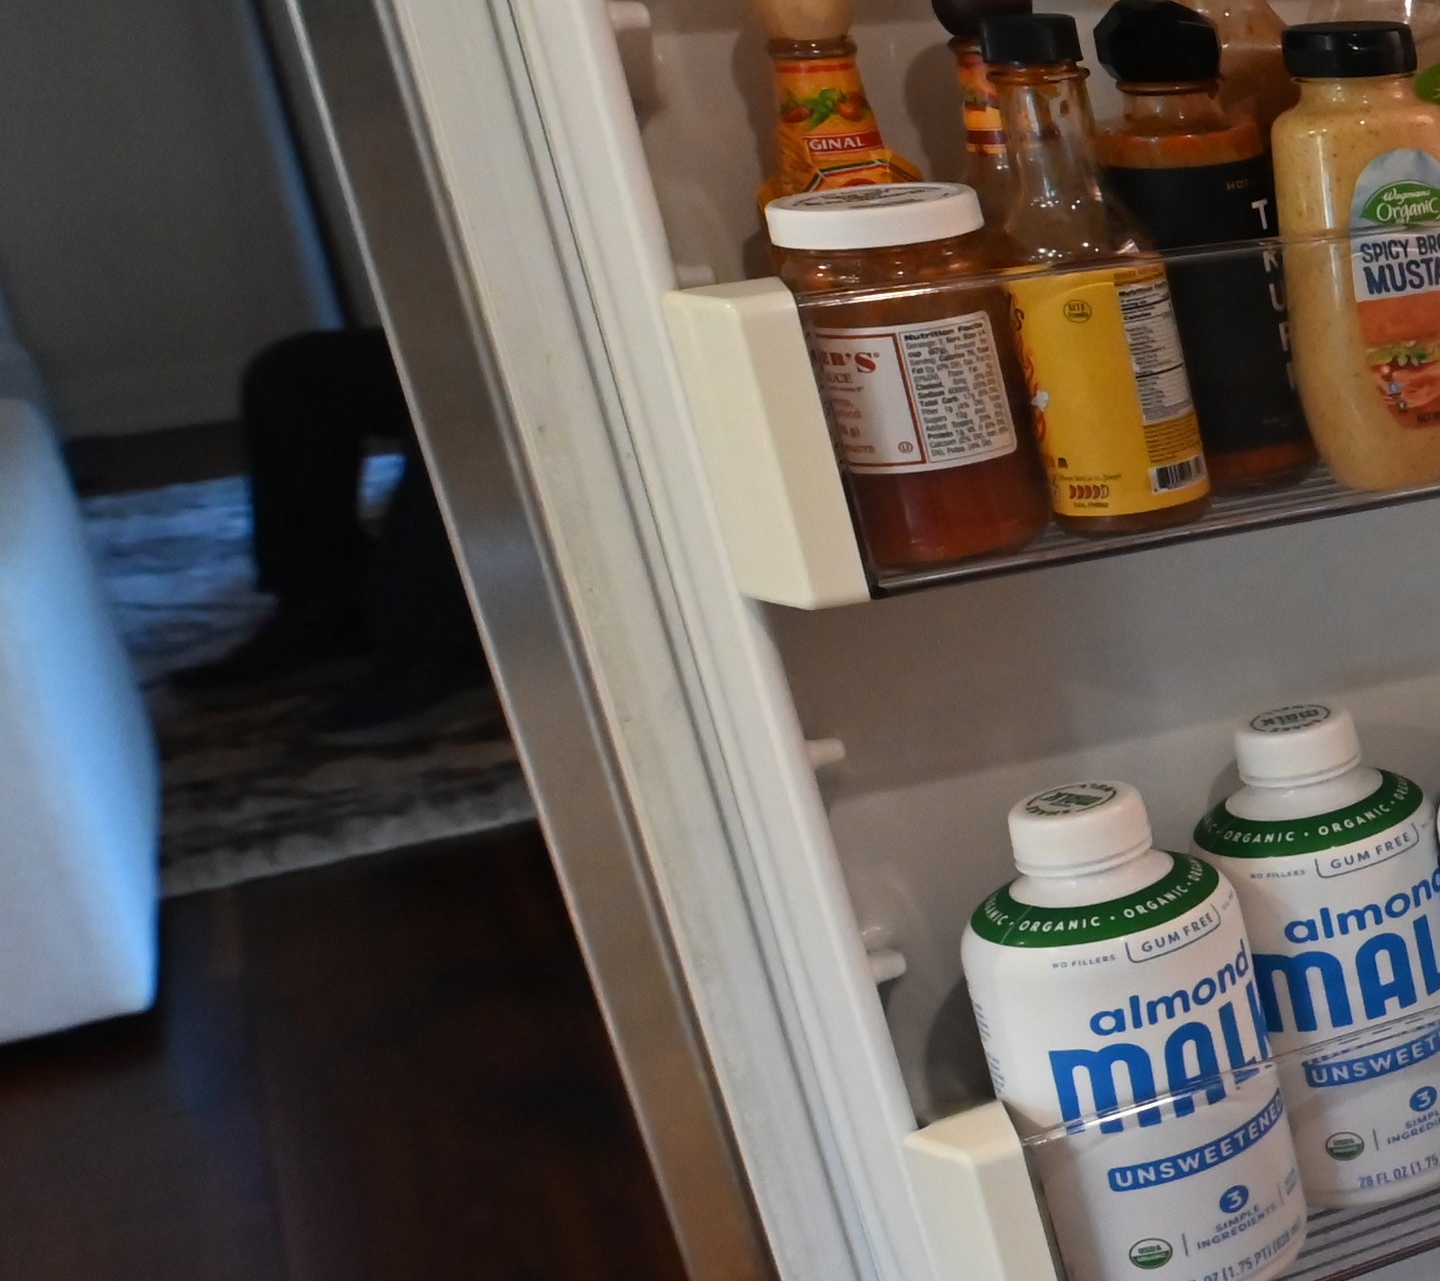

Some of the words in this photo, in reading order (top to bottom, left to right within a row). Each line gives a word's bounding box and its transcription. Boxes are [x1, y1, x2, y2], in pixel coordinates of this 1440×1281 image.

[1383, 188, 1430, 203] Wegmans
[1377, 198, 1439, 223] Organic
[1361, 236, 1410, 263] SPICY
[904, 328, 955, 341] Nutrition
[1318, 803, 1390, 836] ORGANIC
[1223, 831, 1295, 843] ORGANIC
[1330, 851, 1370, 870] GUM
[1376, 832, 1411, 855] FREE
[1123, 884, 1189, 918] ORGANIC
[1018, 916, 1100, 932] ORGANIC
[1141, 931, 1180, 953] GUM
[1183, 912, 1214, 937] FREE
[1089, 937, 1249, 1036] almond
[1417, 1091, 1431, 1108] 3
[1230, 1190, 1242, 1209] 3
[1197, 1203, 1276, 1250] INGREDIENTS
[1215, 1205, 1260, 1233] SIMPLE
